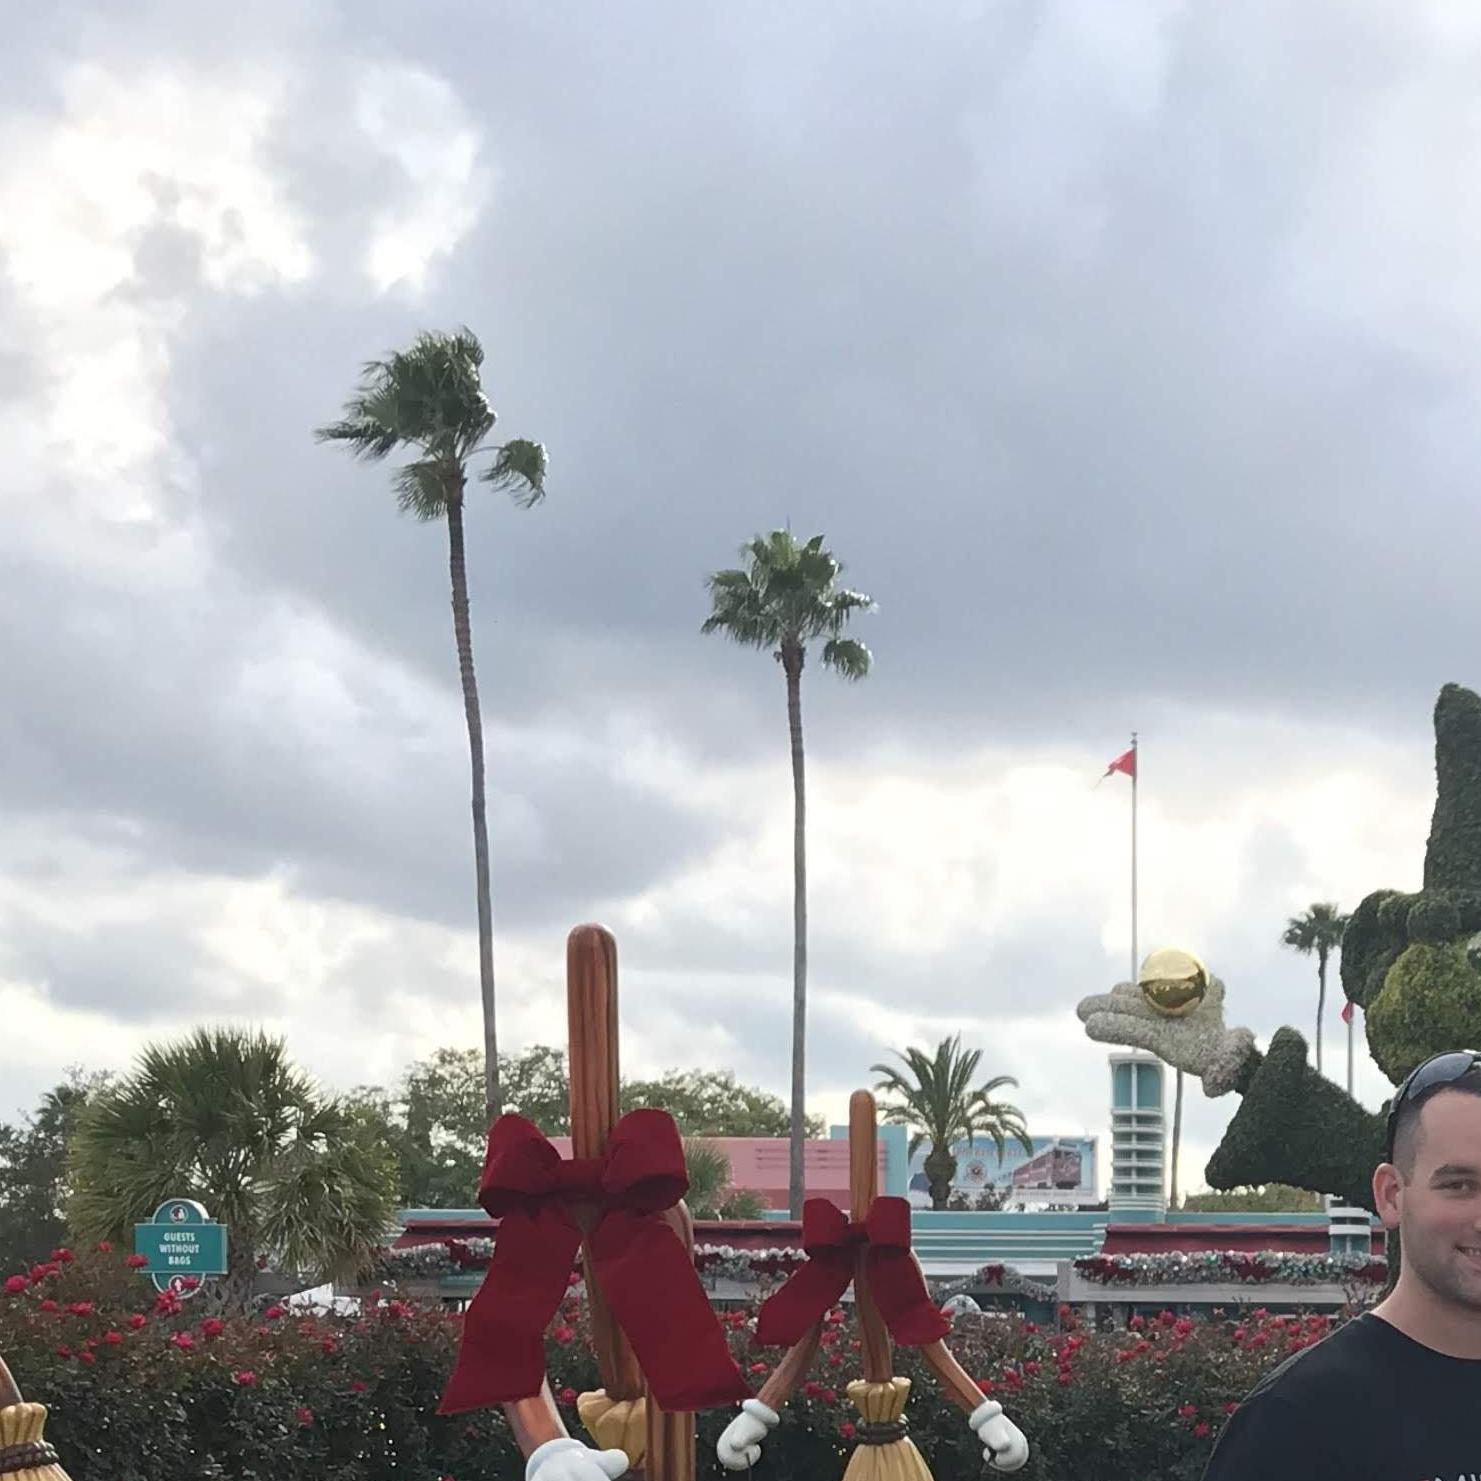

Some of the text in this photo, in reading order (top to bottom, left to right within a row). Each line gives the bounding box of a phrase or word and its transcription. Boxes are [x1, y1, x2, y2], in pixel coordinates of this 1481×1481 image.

[163, 1232, 195, 1242] GUESTS
[159, 1244, 199, 1253] WITHOUT
[168, 1256, 191, 1265] BAGS
